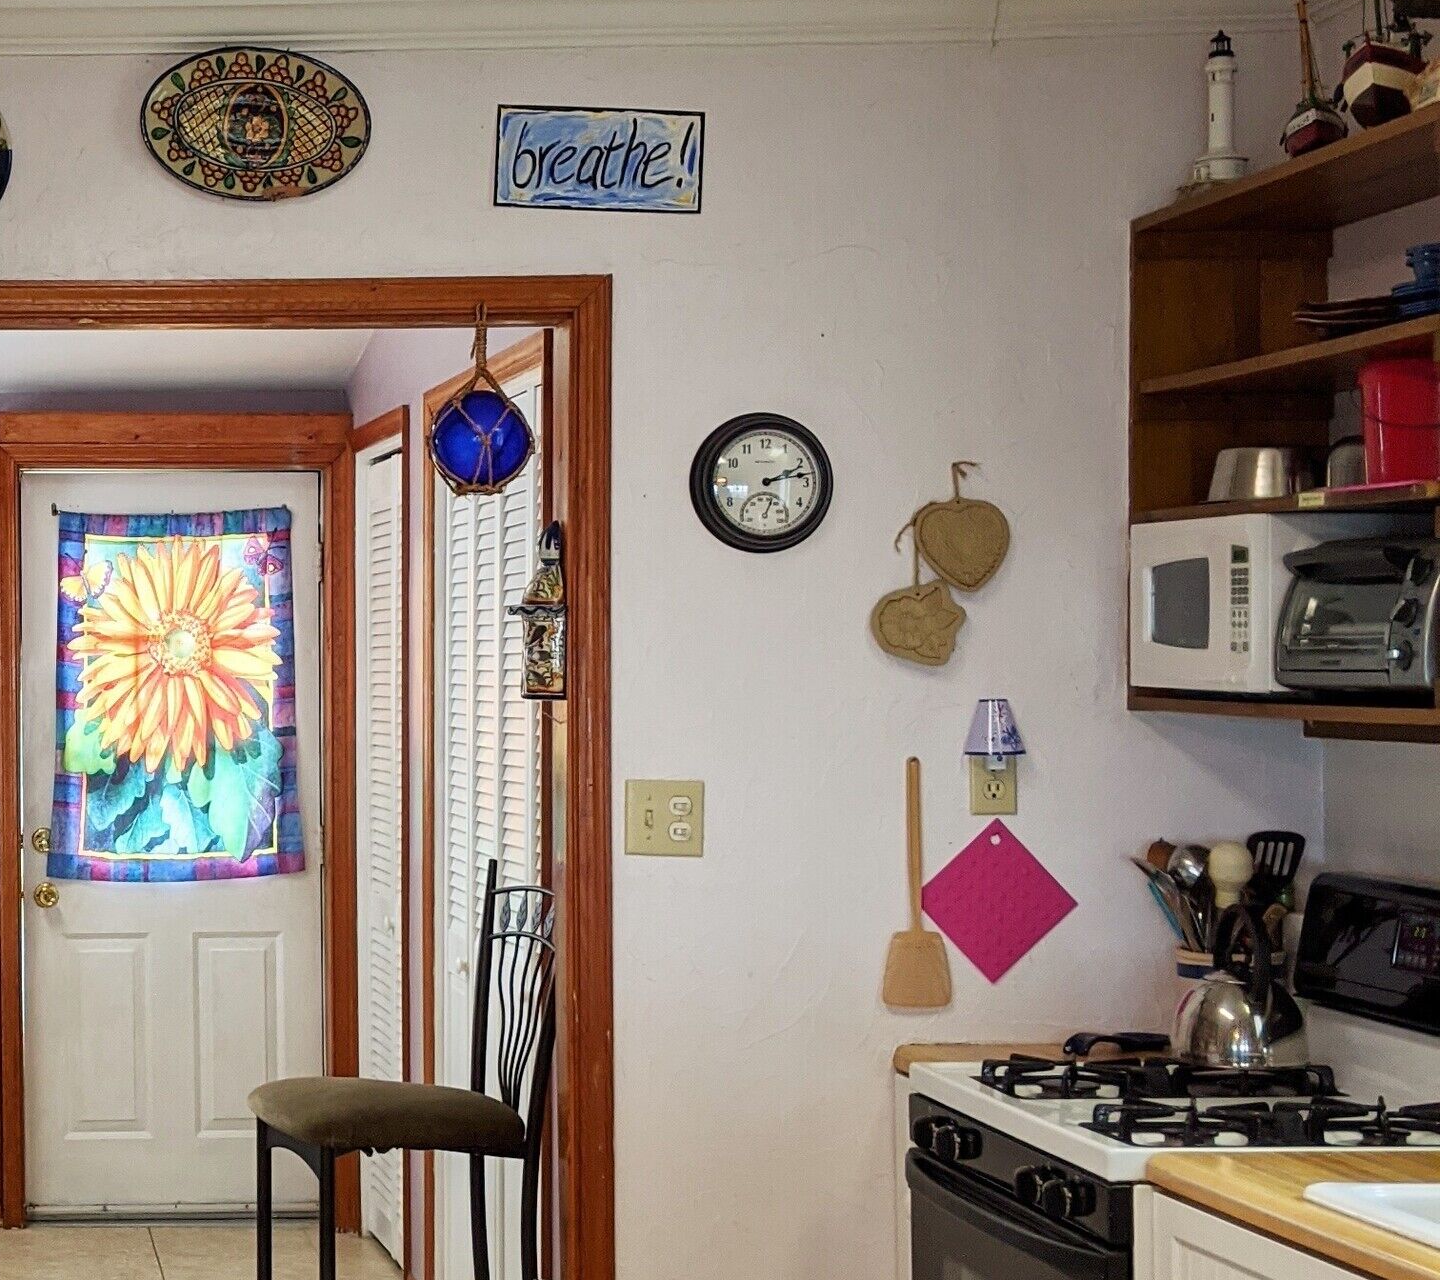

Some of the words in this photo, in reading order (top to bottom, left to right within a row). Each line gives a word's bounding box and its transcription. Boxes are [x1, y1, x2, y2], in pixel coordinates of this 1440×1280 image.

[512, 118, 695, 190] breathe!
[759, 438, 772, 449] 12
[742, 444, 751, 454] 11
[783, 444, 788, 454] 1
[727, 458, 739, 468] 10
[802, 477, 810, 488] 3
